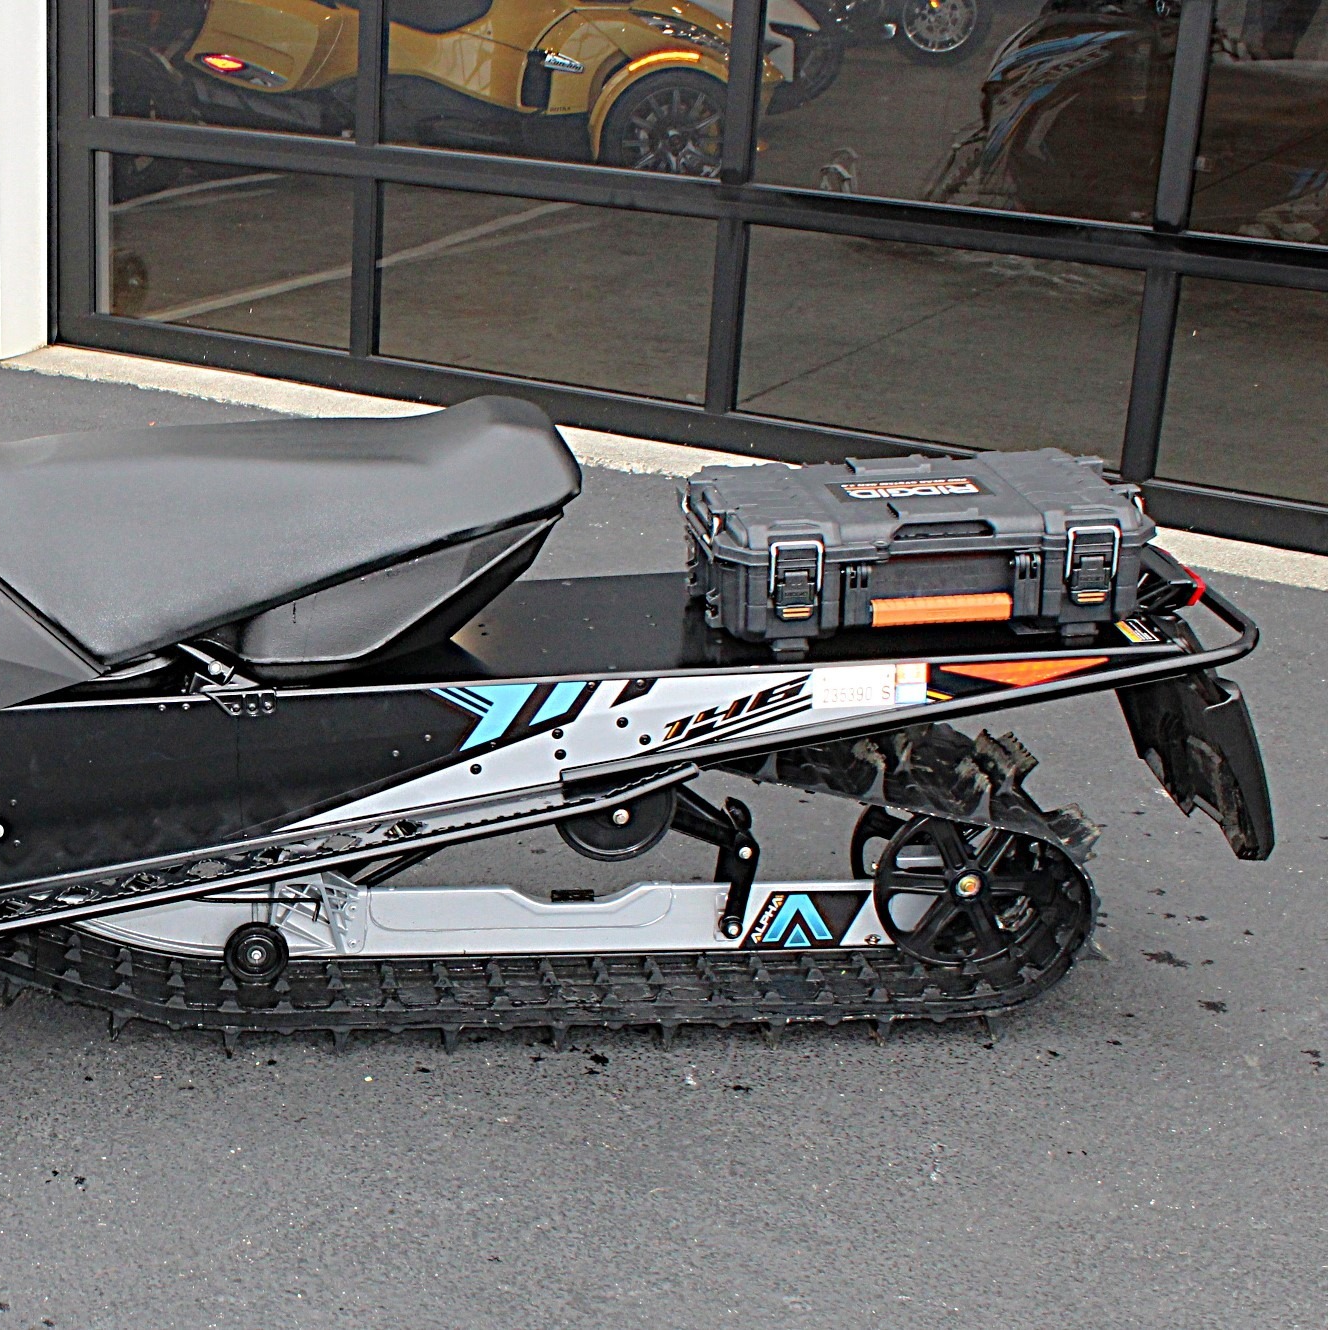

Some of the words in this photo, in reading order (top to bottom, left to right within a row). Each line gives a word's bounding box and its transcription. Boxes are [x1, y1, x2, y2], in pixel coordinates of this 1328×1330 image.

[847, 483, 980, 498] RIDGID
[823, 686, 872, 704] 235390
[881, 685, 891, 700] S
[661, 673, 811, 742] 146
